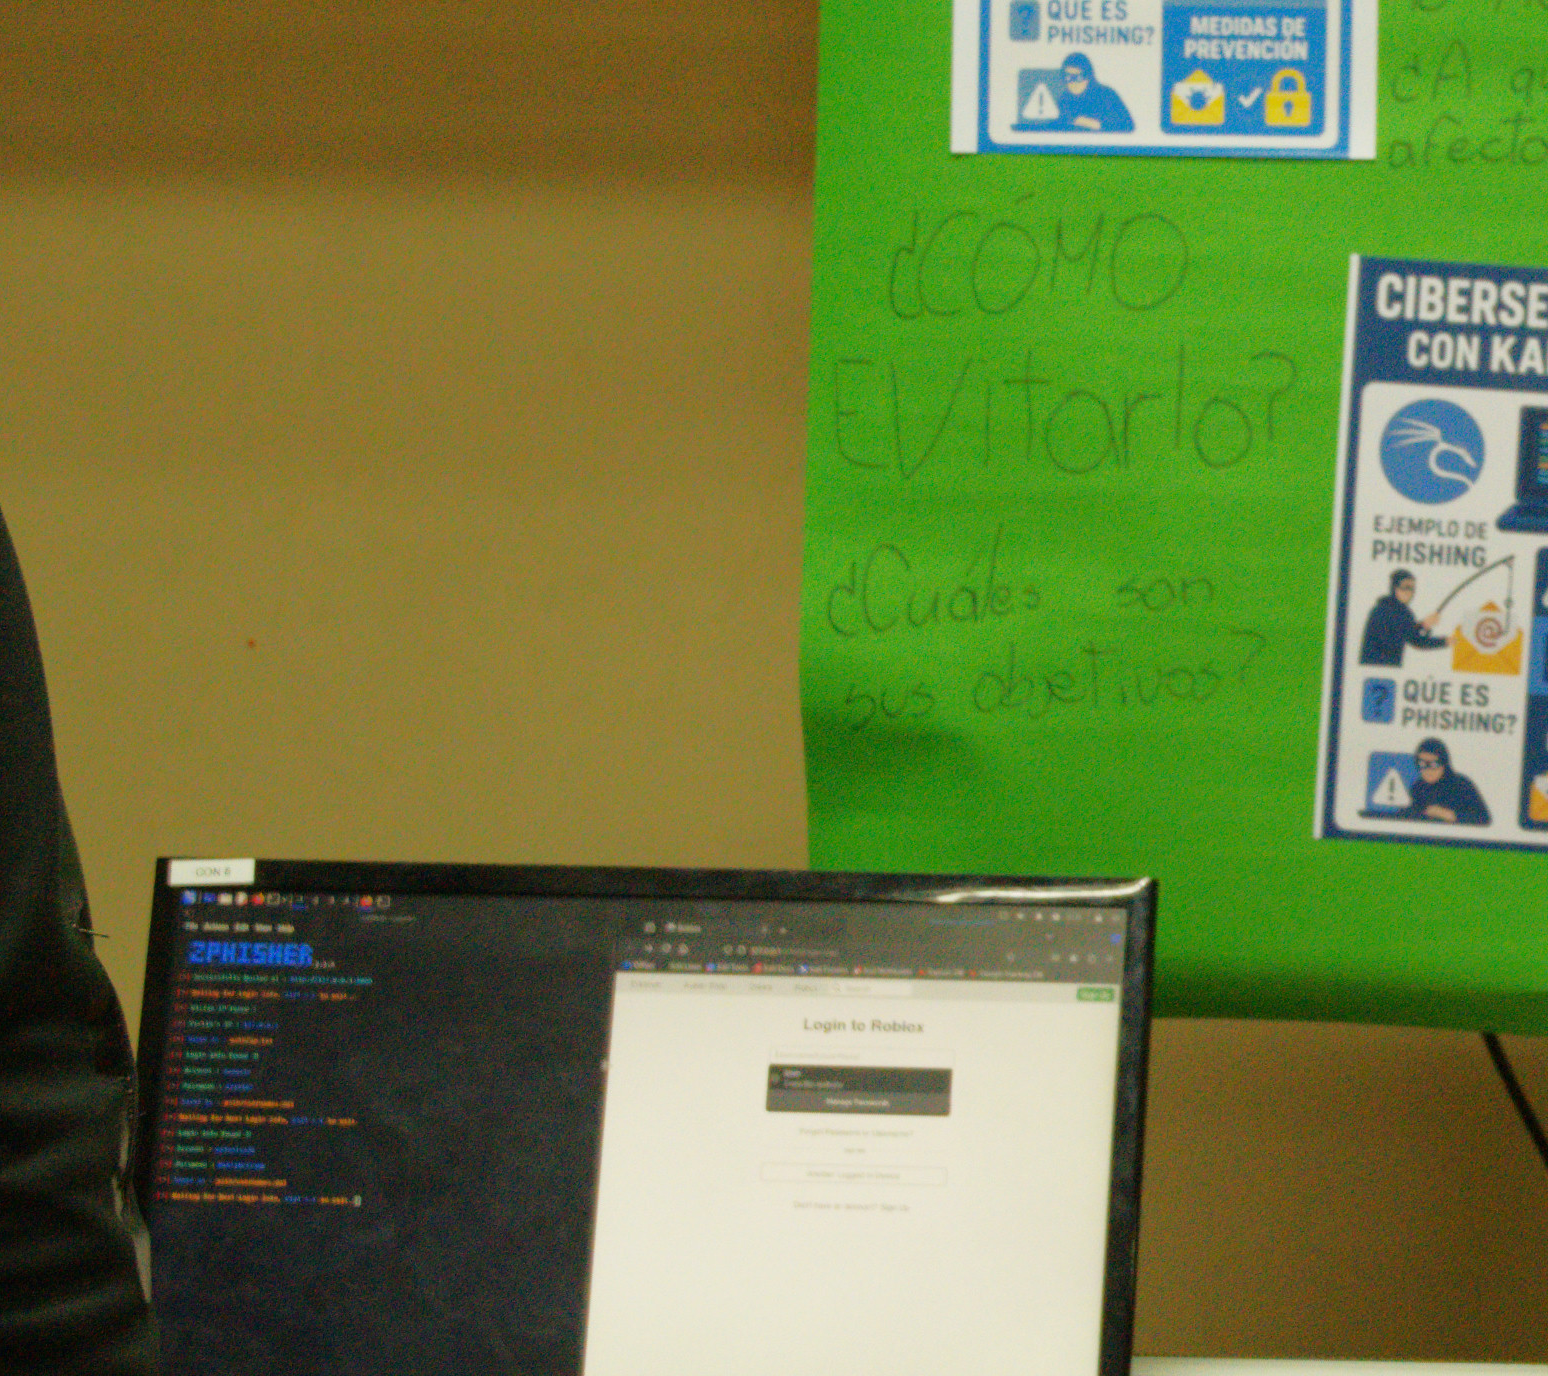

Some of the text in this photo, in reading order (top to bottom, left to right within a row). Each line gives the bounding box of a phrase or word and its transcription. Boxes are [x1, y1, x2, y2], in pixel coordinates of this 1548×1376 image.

[1100, 0, 1129, 21] ES
[1046, 25, 1156, 45] PHISHING?
[1189, 15, 1307, 38] MEDIDAS DE
[1183, 36, 1309, 61] PREVENCIÓN
[1405, 329, 1482, 371] CON
[1373, 514, 1489, 541] EJEMPLO DE
[1371, 538, 1488, 568] PHISHING
[1460, 683, 1490, 707] ES
[1401, 707, 1518, 735] PHISHING?
[802, 1018, 925, 1035] Login to Roblox
